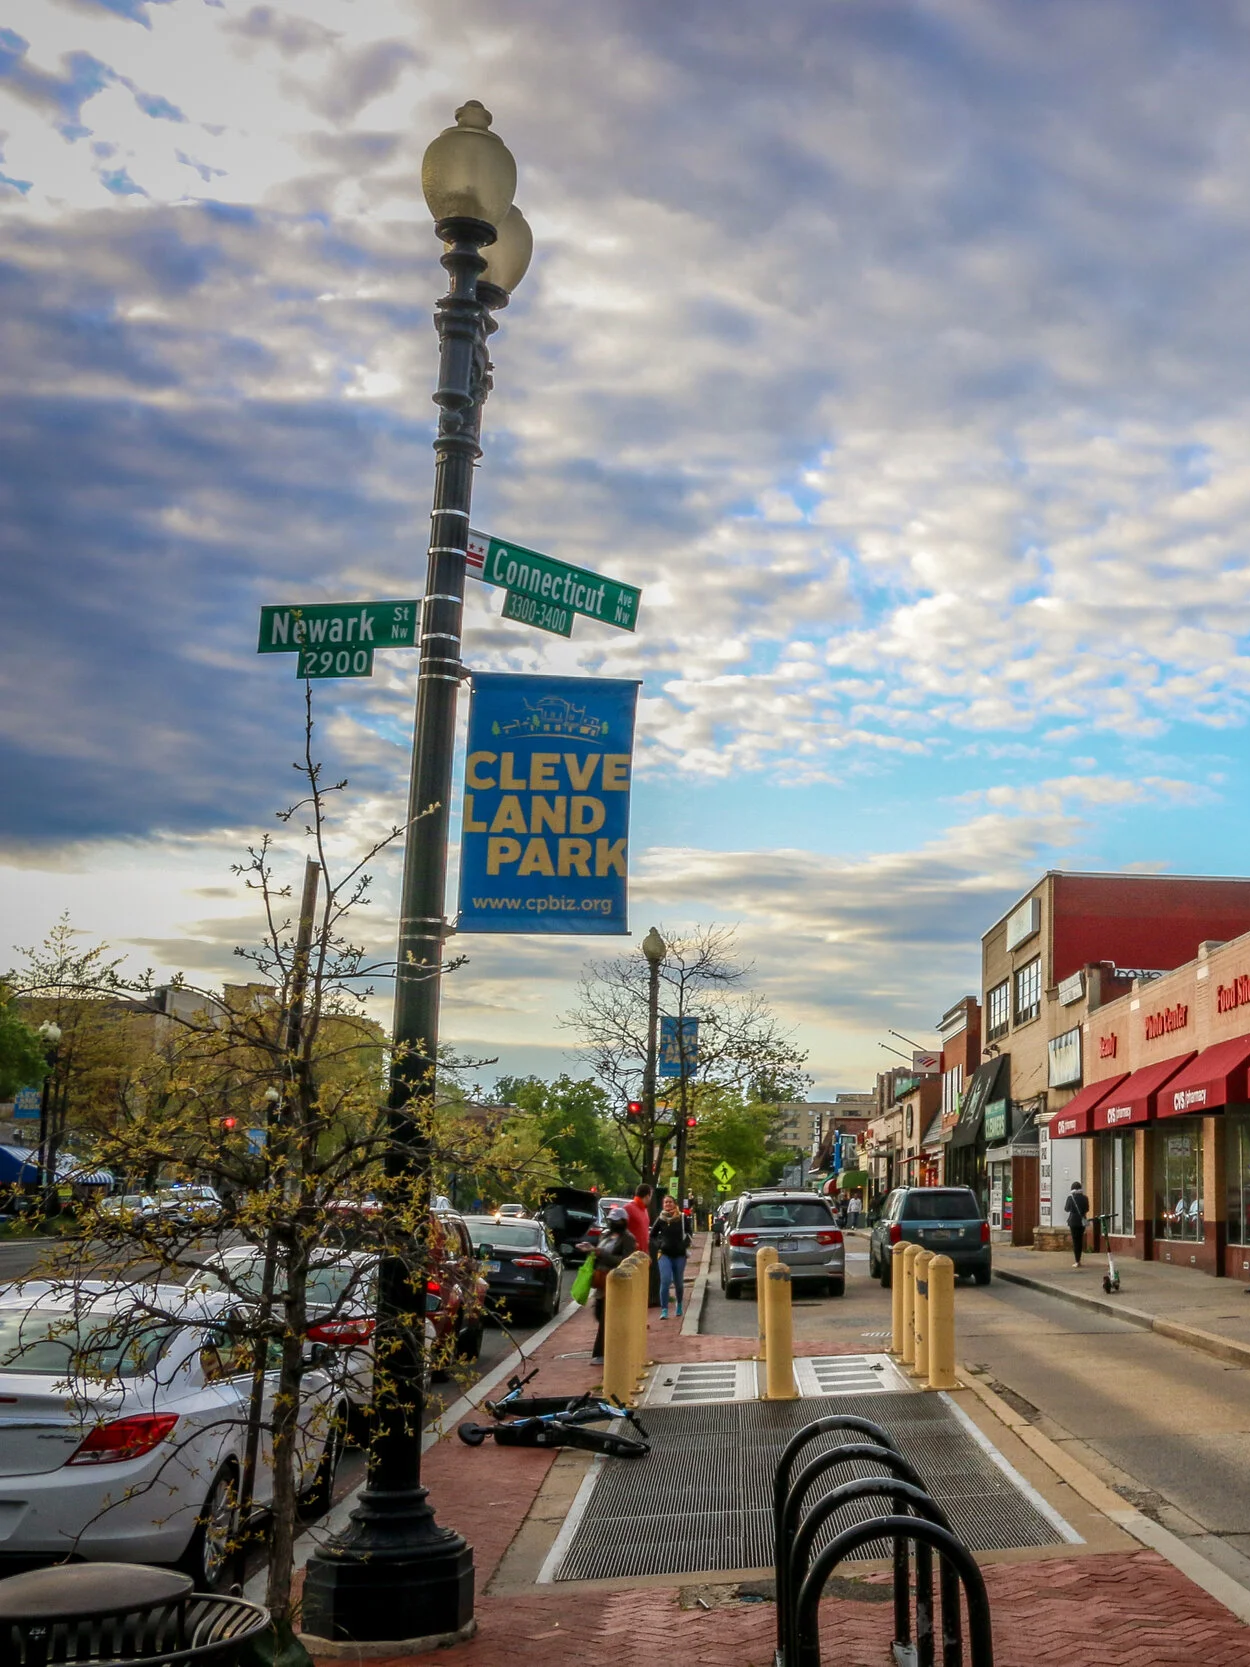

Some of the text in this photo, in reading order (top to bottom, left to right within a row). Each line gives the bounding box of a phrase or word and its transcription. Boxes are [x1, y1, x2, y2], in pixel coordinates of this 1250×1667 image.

[493, 547, 606, 615] Connecticut
[617, 589, 633, 609] Ave
[270, 610, 375, 647] Newark
[392, 606, 410, 622] St
[507, 593, 568, 633] 3300-3400
[303, 649, 369, 676] 2900
[466, 750, 630, 792] CLEVE
[463, 794, 607, 835] LAND
[486, 836, 628, 878] PARK
[472, 893, 613, 915] www.cpbiz.org
[1217, 978, 1238, 1014] Food
